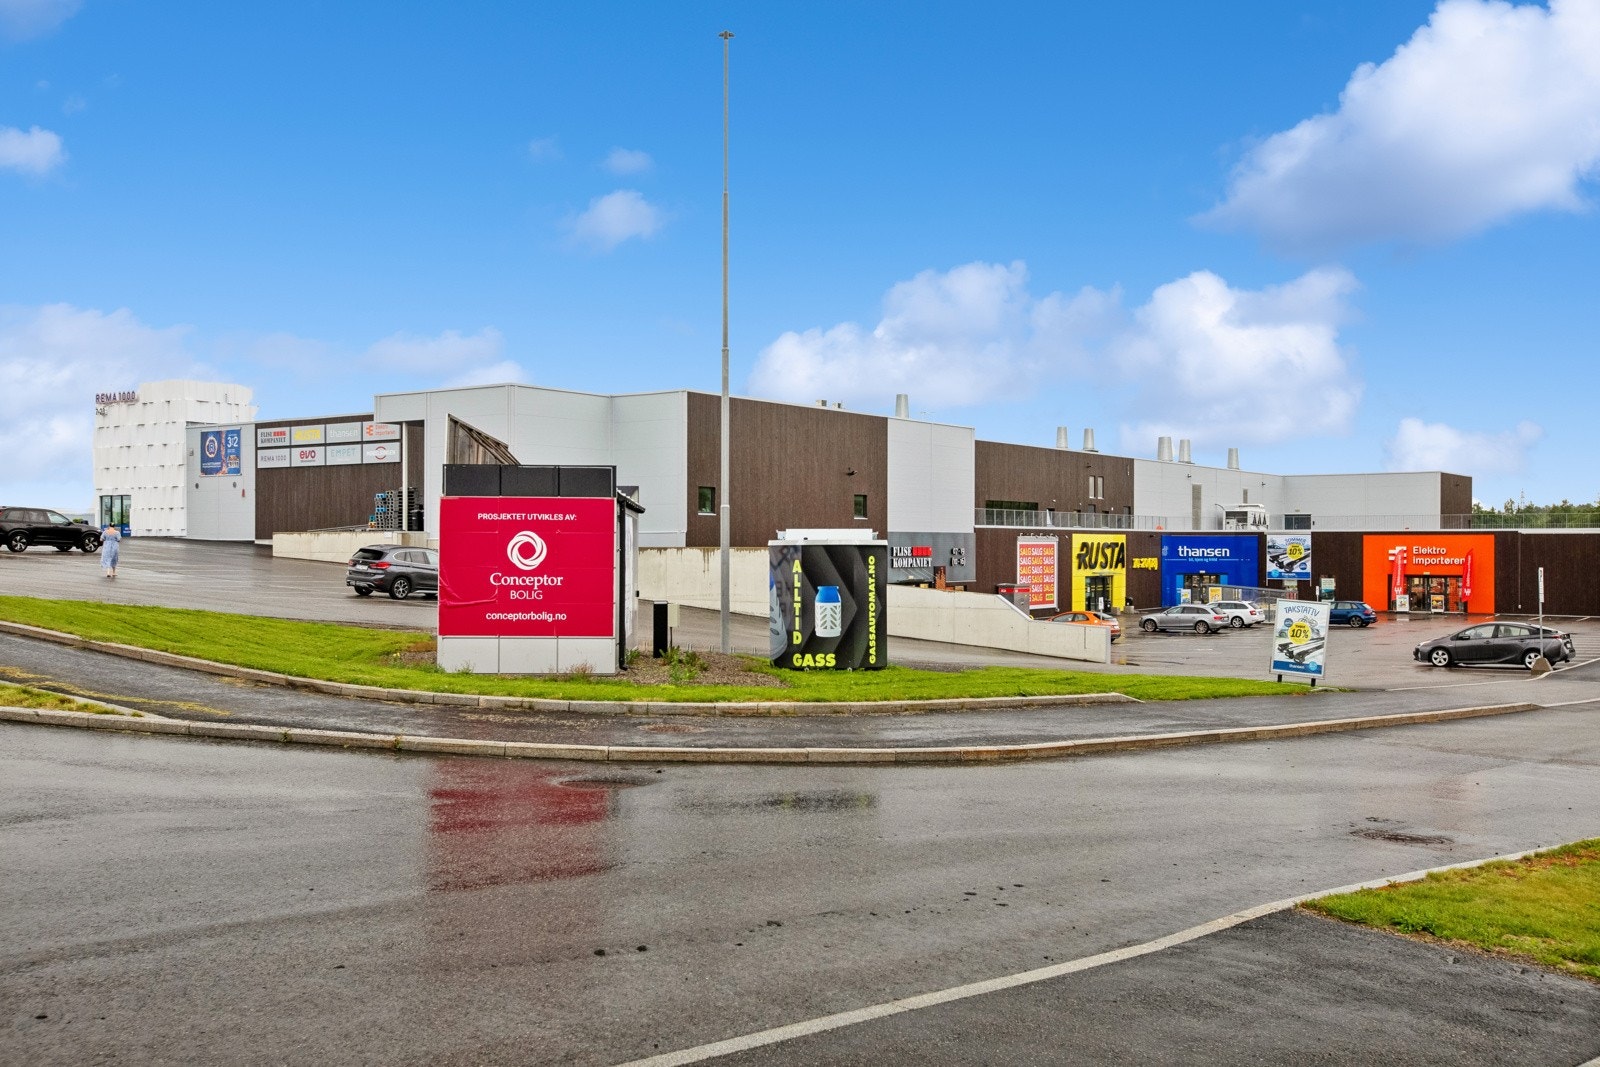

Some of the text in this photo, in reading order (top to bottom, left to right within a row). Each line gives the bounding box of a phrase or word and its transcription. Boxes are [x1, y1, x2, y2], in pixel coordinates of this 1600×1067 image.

[96, 391, 136, 403] REMA 1000
[300, 450, 316, 459] evo
[893, 546, 912, 556] FLISE
[1032, 547, 1043, 556] SALG
[1178, 546, 1230, 556] thansen
[1413, 546, 1446, 554] Elektro
[1020, 557, 1031, 565] SALG
[1032, 556, 1043, 564] SALG
[1076, 542, 1125, 570] RUSTA
[893, 558, 932, 568] KOMPANIET
[1020, 566, 1031, 574] SALG
[1043, 565, 1054, 573] SALG
[490, 572, 563, 590] Conceptor
[1020, 574, 1054, 584] SALG SALG SALG
[1032, 584, 1043, 592] SALG
[510, 590, 543, 600] BOLIG
[792, 560, 802, 645] ALLTID
[868, 555, 876, 664] GASSAUTOMAT.NO
[1284, 606, 1320, 617] TAKSTATIV
[486, 611, 567, 622] conceptorbolig.no
[1290, 629, 1309, 639] 10%
[792, 654, 836, 667] GASS
